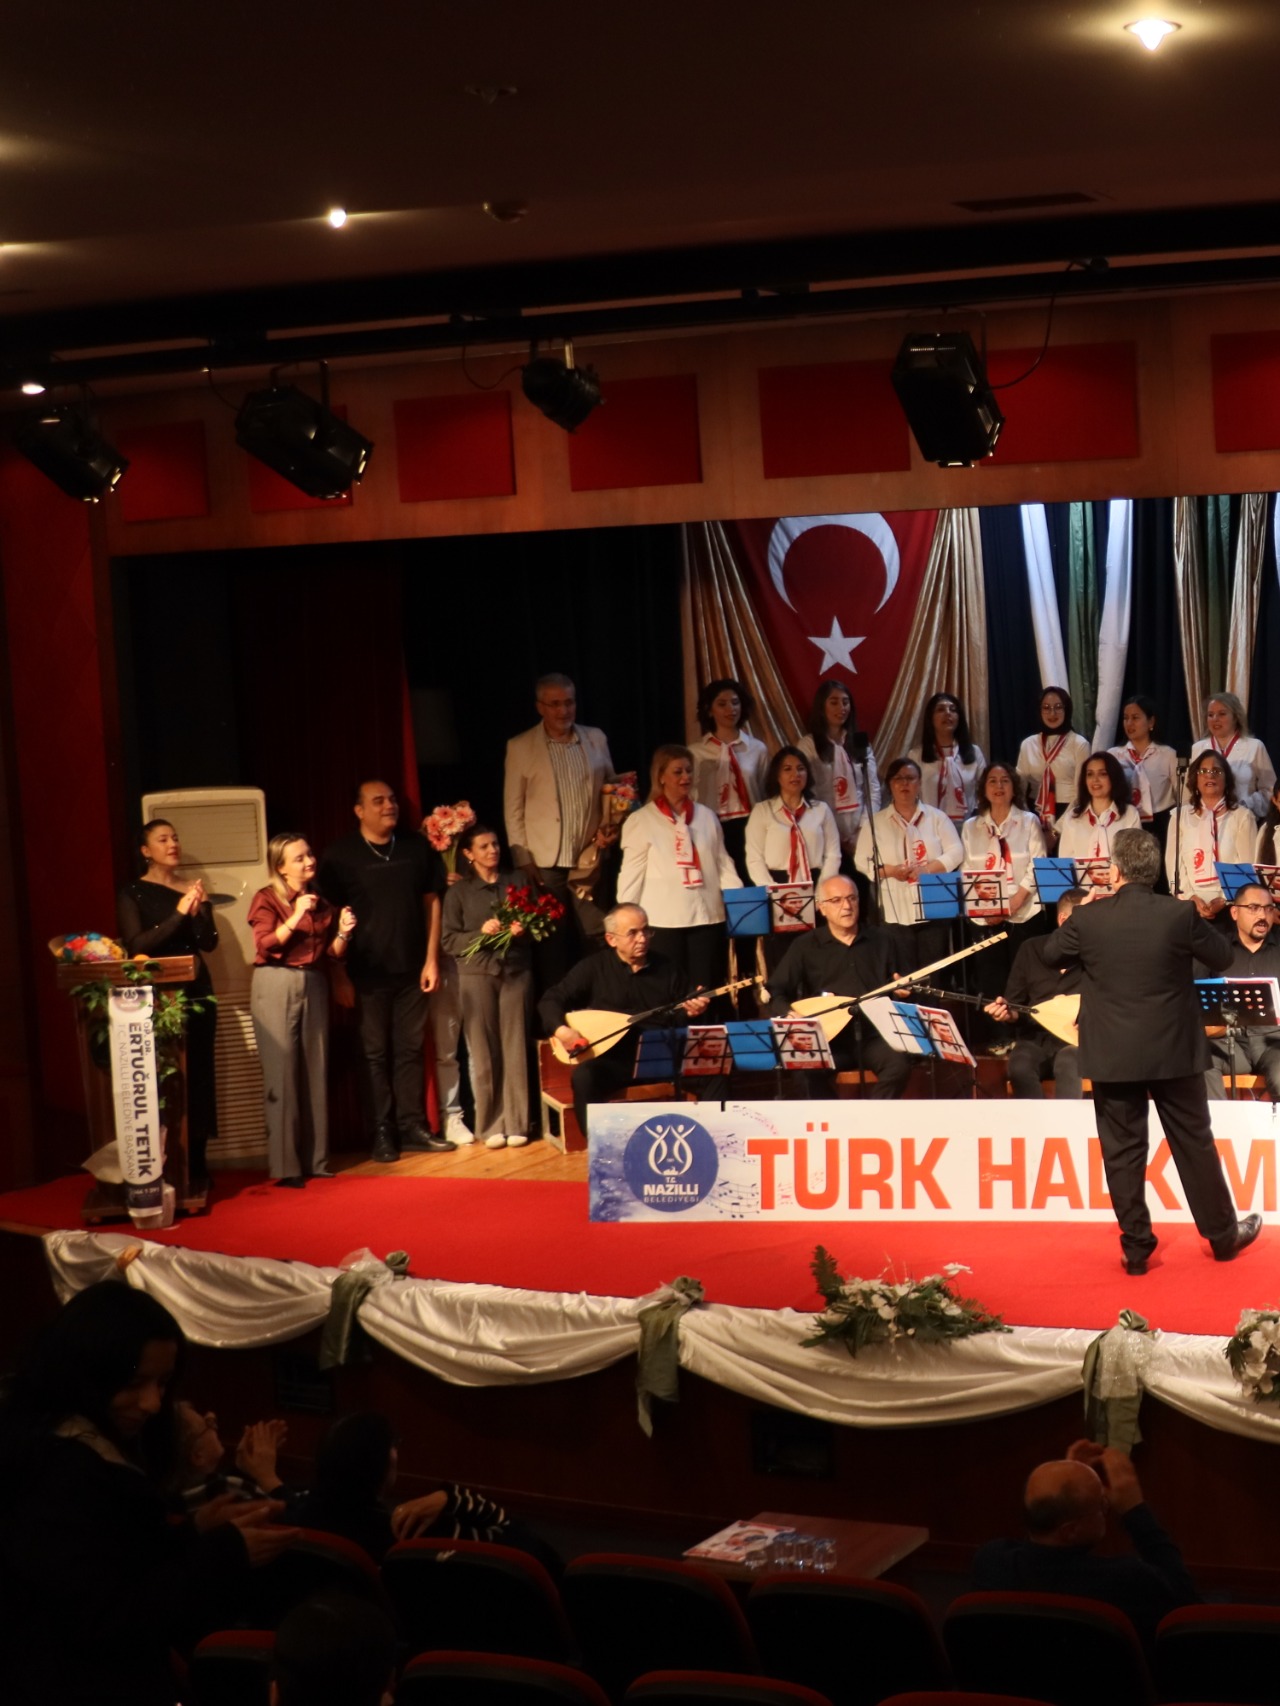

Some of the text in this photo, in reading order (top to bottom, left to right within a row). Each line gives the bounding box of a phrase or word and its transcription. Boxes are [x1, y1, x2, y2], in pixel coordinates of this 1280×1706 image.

[129, 1022, 150, 1119] ERTUĞRUL
[145, 1040, 153, 1055] DR.
[136, 1123, 156, 1177] TETİK
[746, 1121, 951, 1211] TÜRK
[977, 1137, 1183, 1211] HALK
